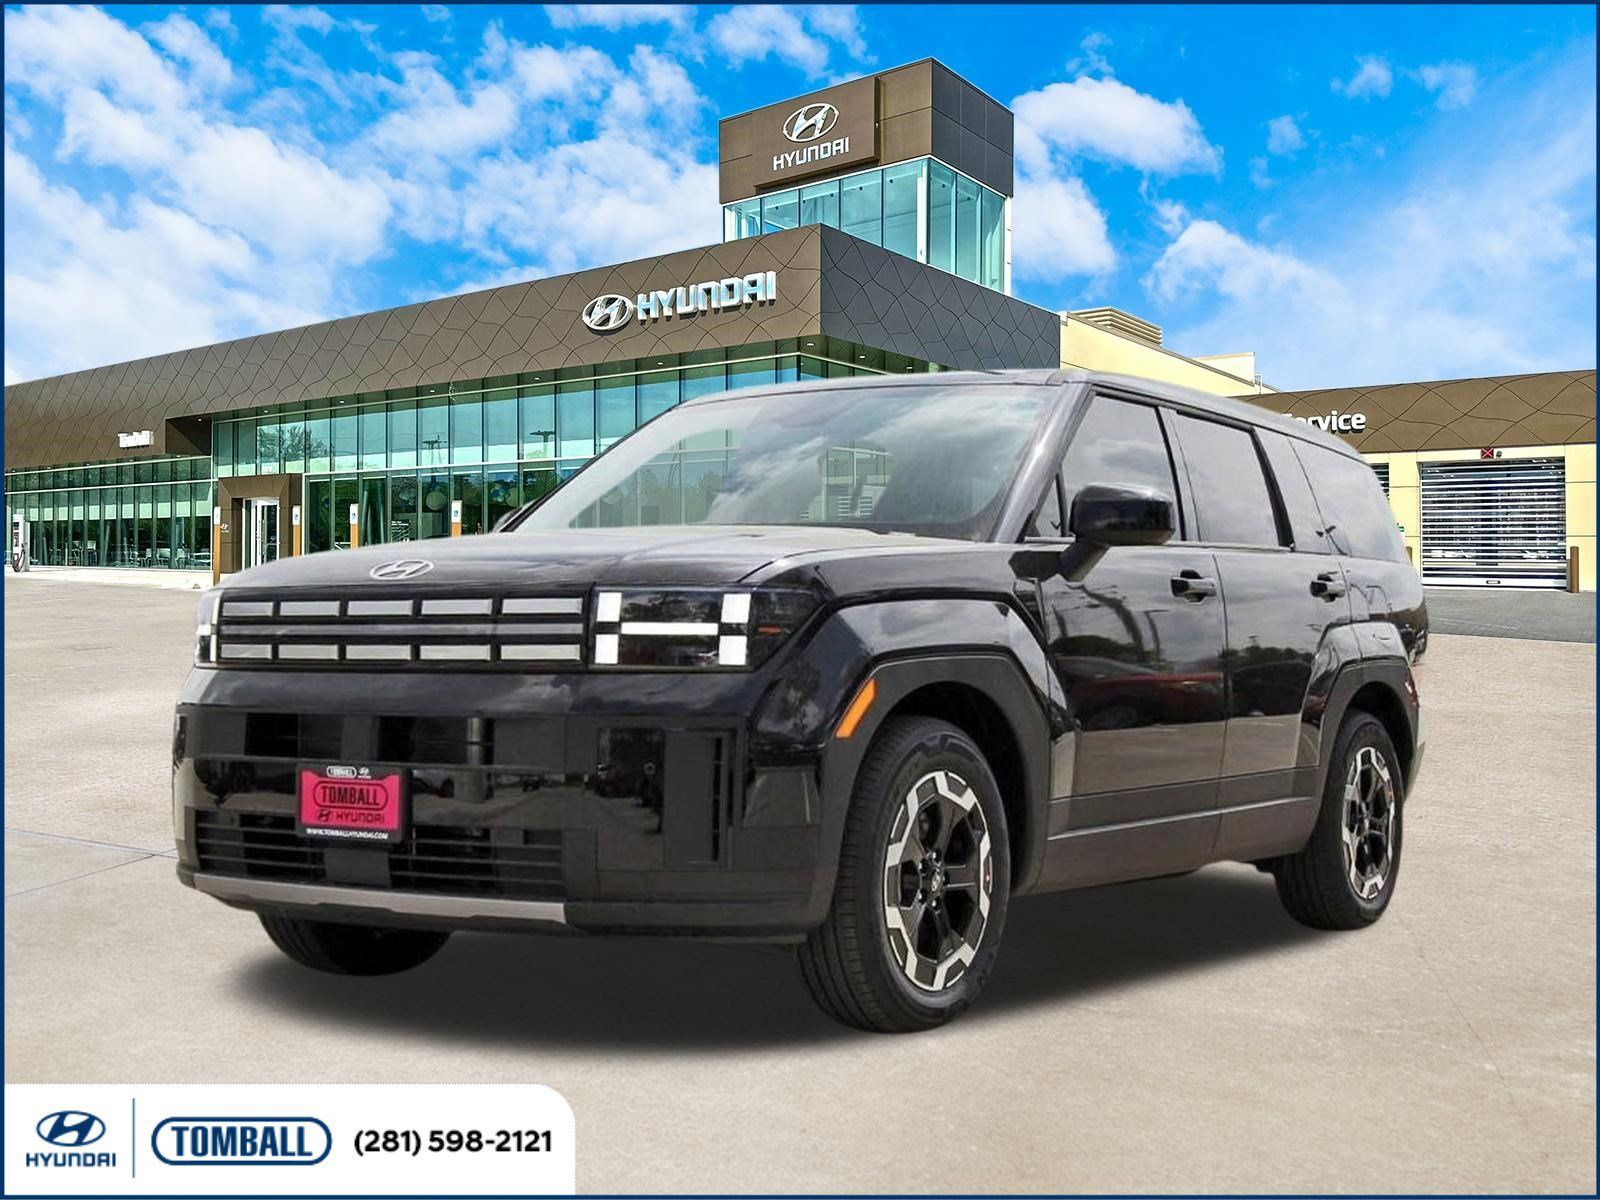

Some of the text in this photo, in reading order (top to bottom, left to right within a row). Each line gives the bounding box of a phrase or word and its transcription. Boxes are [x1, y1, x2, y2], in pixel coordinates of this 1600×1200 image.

[773, 136, 850, 171] HYUNDAI
[637, 270, 777, 321] HYUNDAI
[1281, 410, 1367, 431] rvice
[320, 785, 380, 806] TOMBALL
[336, 811, 385, 823] HYUNDAI
